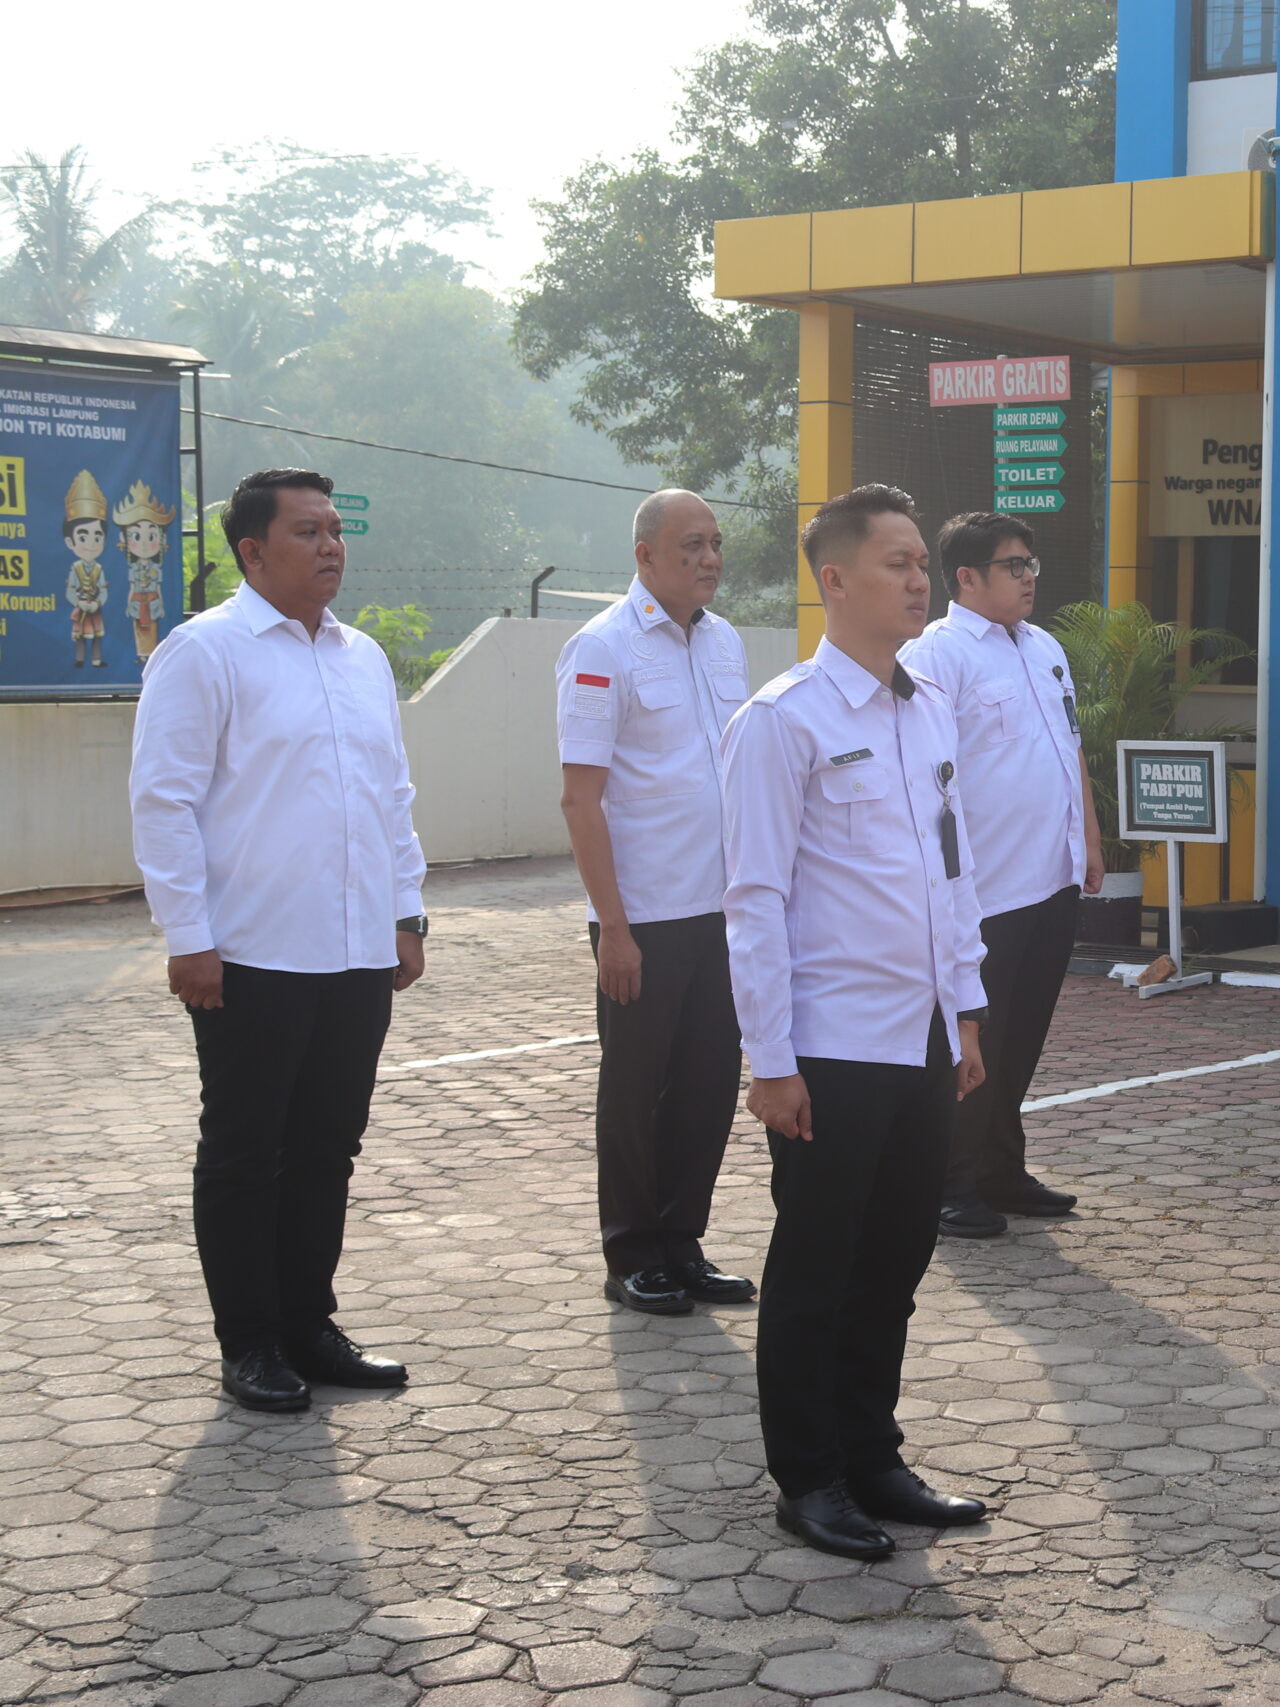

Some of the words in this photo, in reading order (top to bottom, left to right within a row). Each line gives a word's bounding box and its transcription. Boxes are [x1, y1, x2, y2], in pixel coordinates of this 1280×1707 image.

[933, 365, 996, 400] PARKIR
[1002, 360, 1067, 396] GRATIS
[33, 391, 83, 407] REPUBLIK
[85, 396, 137, 411] INDONESIA
[3, 403, 49, 417] IMIGRASI
[52, 407, 99, 422] LAMPUNG
[997, 413, 1028, 426] PARKIR
[1030, 412, 1058, 425] DEPAN
[27, 420, 52, 436] TPI
[56, 423, 126, 442] KOTABUMI
[995, 441, 1018, 453] RUANG
[1020, 440, 1058, 452] PELAYANAN
[1202, 438, 1262, 471] Peng
[998, 467, 1057, 482] TOILET
[1164, 476, 1213, 494] Warga
[996, 495, 1056, 509] KELUAR
[0, 592, 56, 613] Korupsi
[1140, 763, 1202, 782] PARKIR
[1140, 783, 1203, 798] TABI'PUN
